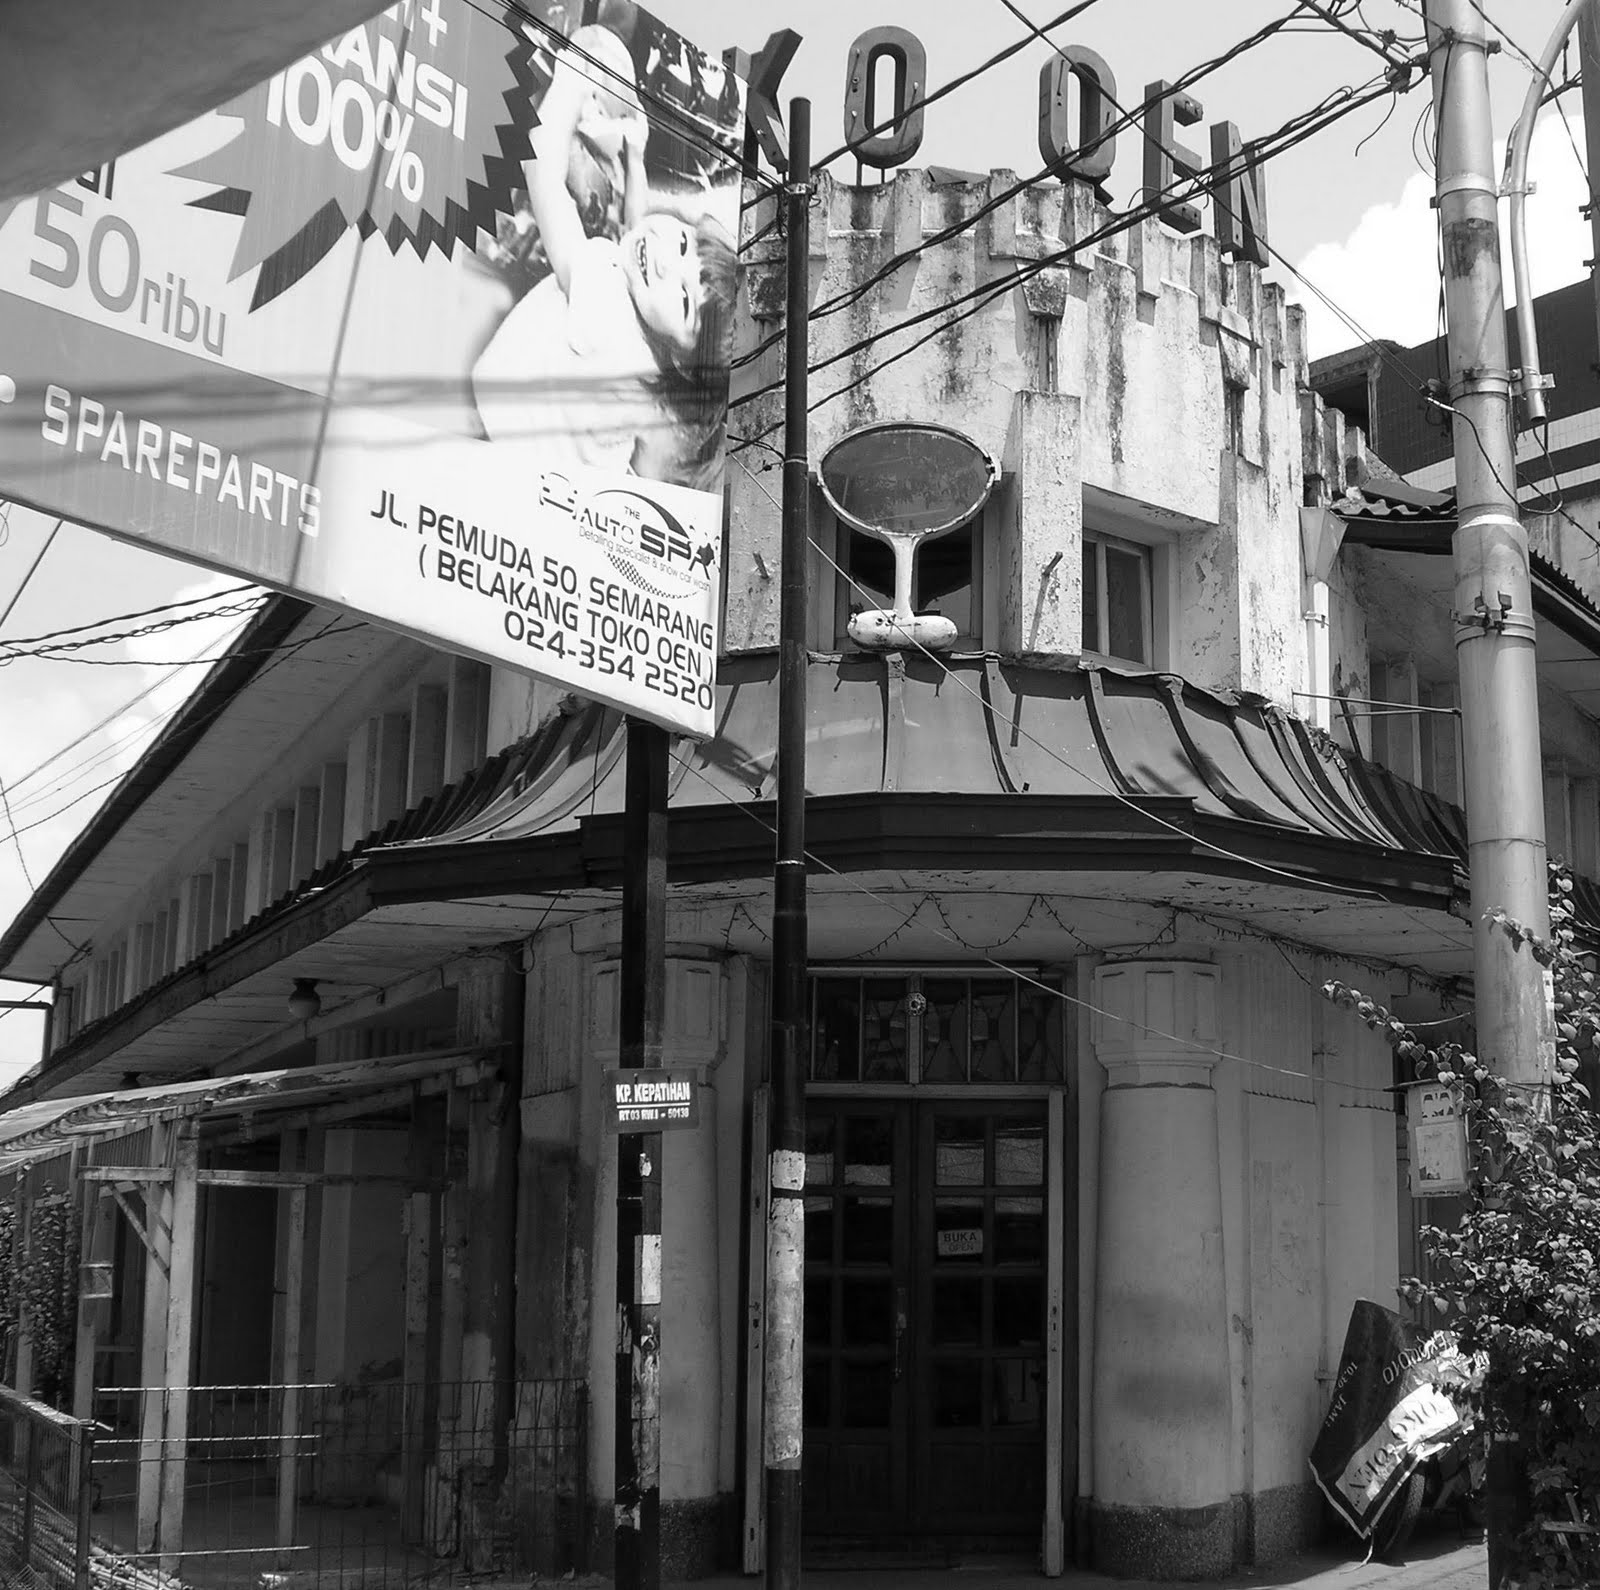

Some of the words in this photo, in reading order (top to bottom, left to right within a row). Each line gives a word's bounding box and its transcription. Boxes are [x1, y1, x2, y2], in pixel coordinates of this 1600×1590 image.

[266, 55, 424, 203] 100%
[321, 24, 468, 141] ANSI
[1038, 44, 1269, 268] OEN
[42, 384, 321, 538] SPAREPARTS
[624, 506, 641, 520] THE
[370, 490, 407, 529] JL.
[418, 504, 535, 578] PEMUDA
[589, 576, 713, 651] SEMARANG
[580, 508, 634, 545] AUTO
[437, 551, 579, 632] BELAKANG
[586, 608, 650, 656] TOKO
[657, 637, 702, 678] OEN
[504, 611, 636, 682] 024-354
[644, 661, 713, 711] 2520
[616, 1083, 632, 1103] KP.
[634, 1082, 690, 1103] KEPATIHAN
[943, 1231, 977, 1242] BUKA
